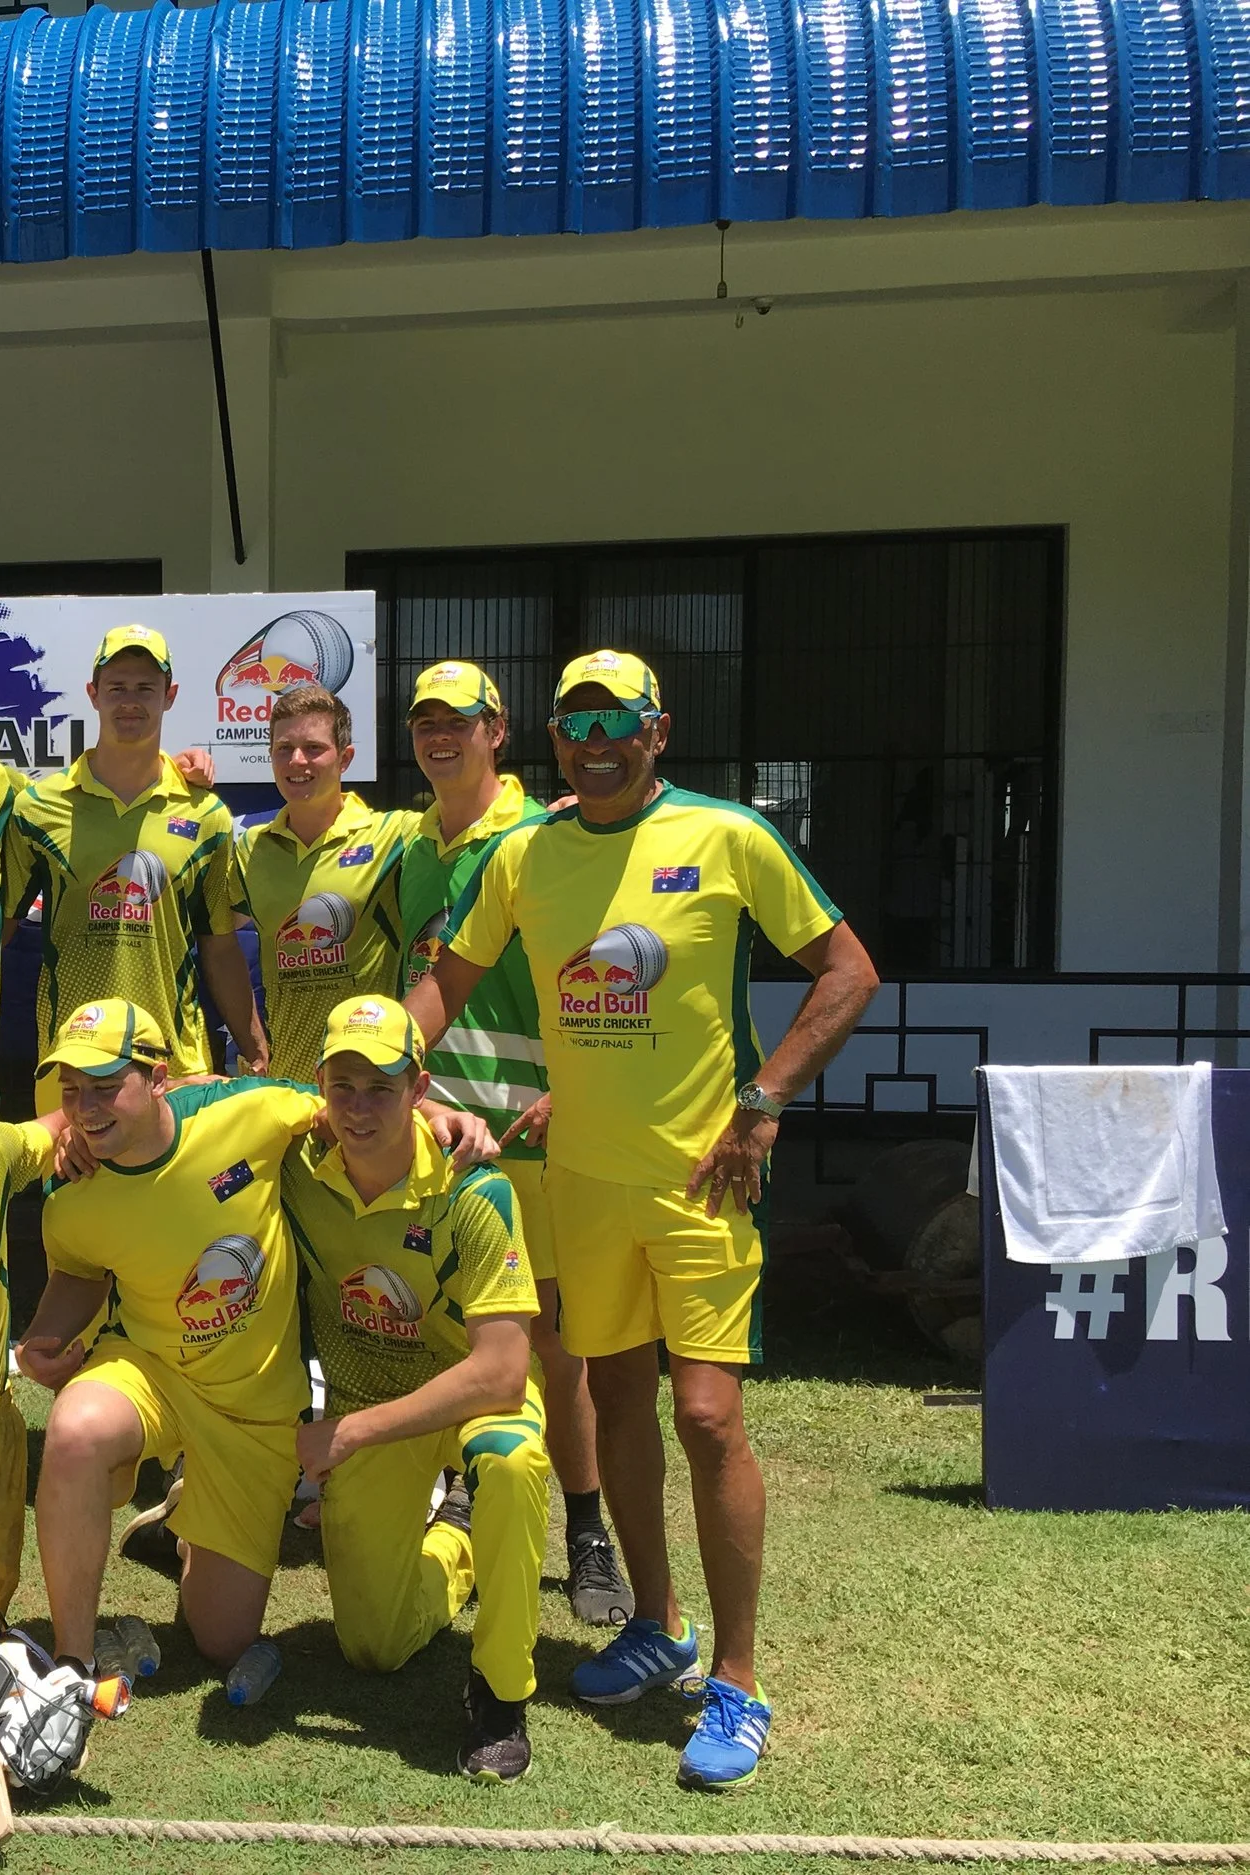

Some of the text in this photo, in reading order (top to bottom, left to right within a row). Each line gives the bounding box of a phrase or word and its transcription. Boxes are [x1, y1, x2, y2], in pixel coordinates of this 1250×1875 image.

[218, 696, 271, 722] Red
[216, 728, 270, 740] CAMPUS
[90, 901, 152, 921] Red Bull
[88, 922, 153, 933] CAMPUS CRICKET
[277, 943, 345, 969] Red Bull
[278, 964, 349, 980] CAMPUS CRICKET
[560, 992, 648, 1014] Red Bull
[559, 1017, 652, 1029] CAMPUS CRICKET
[570, 1037, 633, 1049] WORLD FINALS
[181, 1307, 226, 1331] Red
[182, 1327, 228, 1343] CAMPUS
